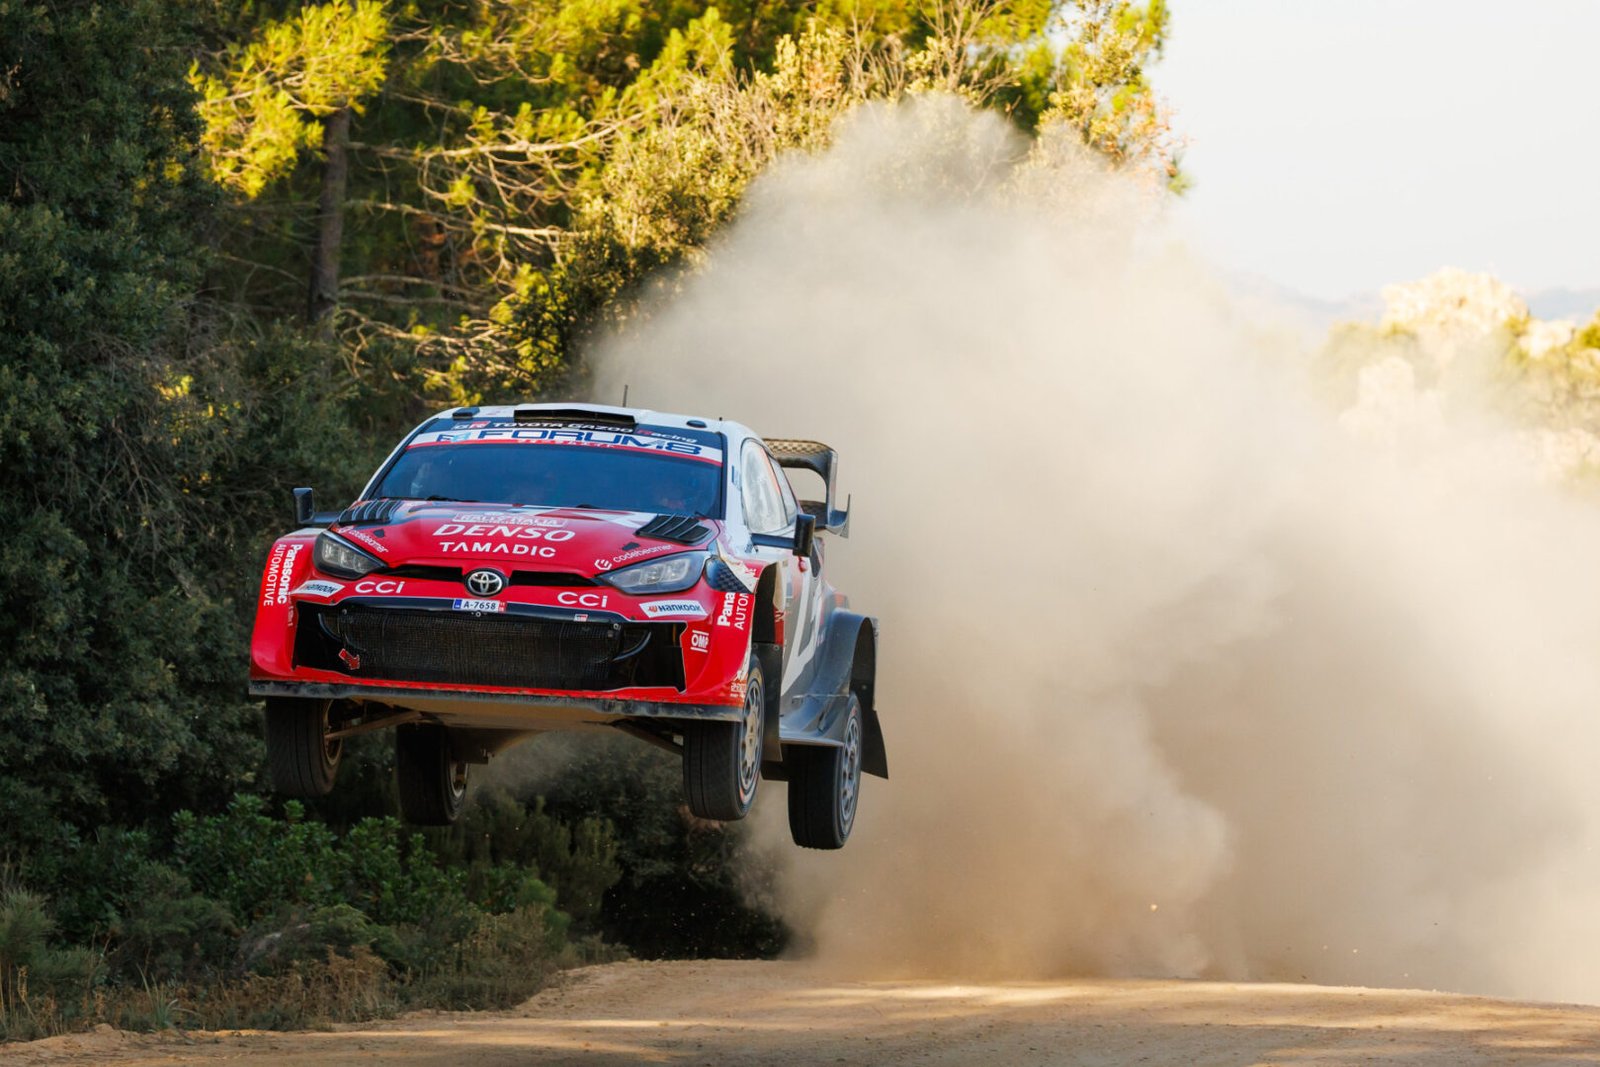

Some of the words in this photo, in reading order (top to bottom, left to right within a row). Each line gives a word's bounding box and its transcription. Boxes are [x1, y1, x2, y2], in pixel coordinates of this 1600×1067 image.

[478, 429, 703, 455] FORUM8
[493, 421, 563, 429] TOYOTA
[567, 423, 634, 434] GAZOO
[636, 429, 698, 443] Racing
[432, 523, 576, 542] DENSO
[439, 541, 557, 558] TAMADIC
[263, 543, 287, 607] AUTOMOTIVE
[277, 543, 304, 605] Panasonic
[463, 600, 497, 611] A-7658
